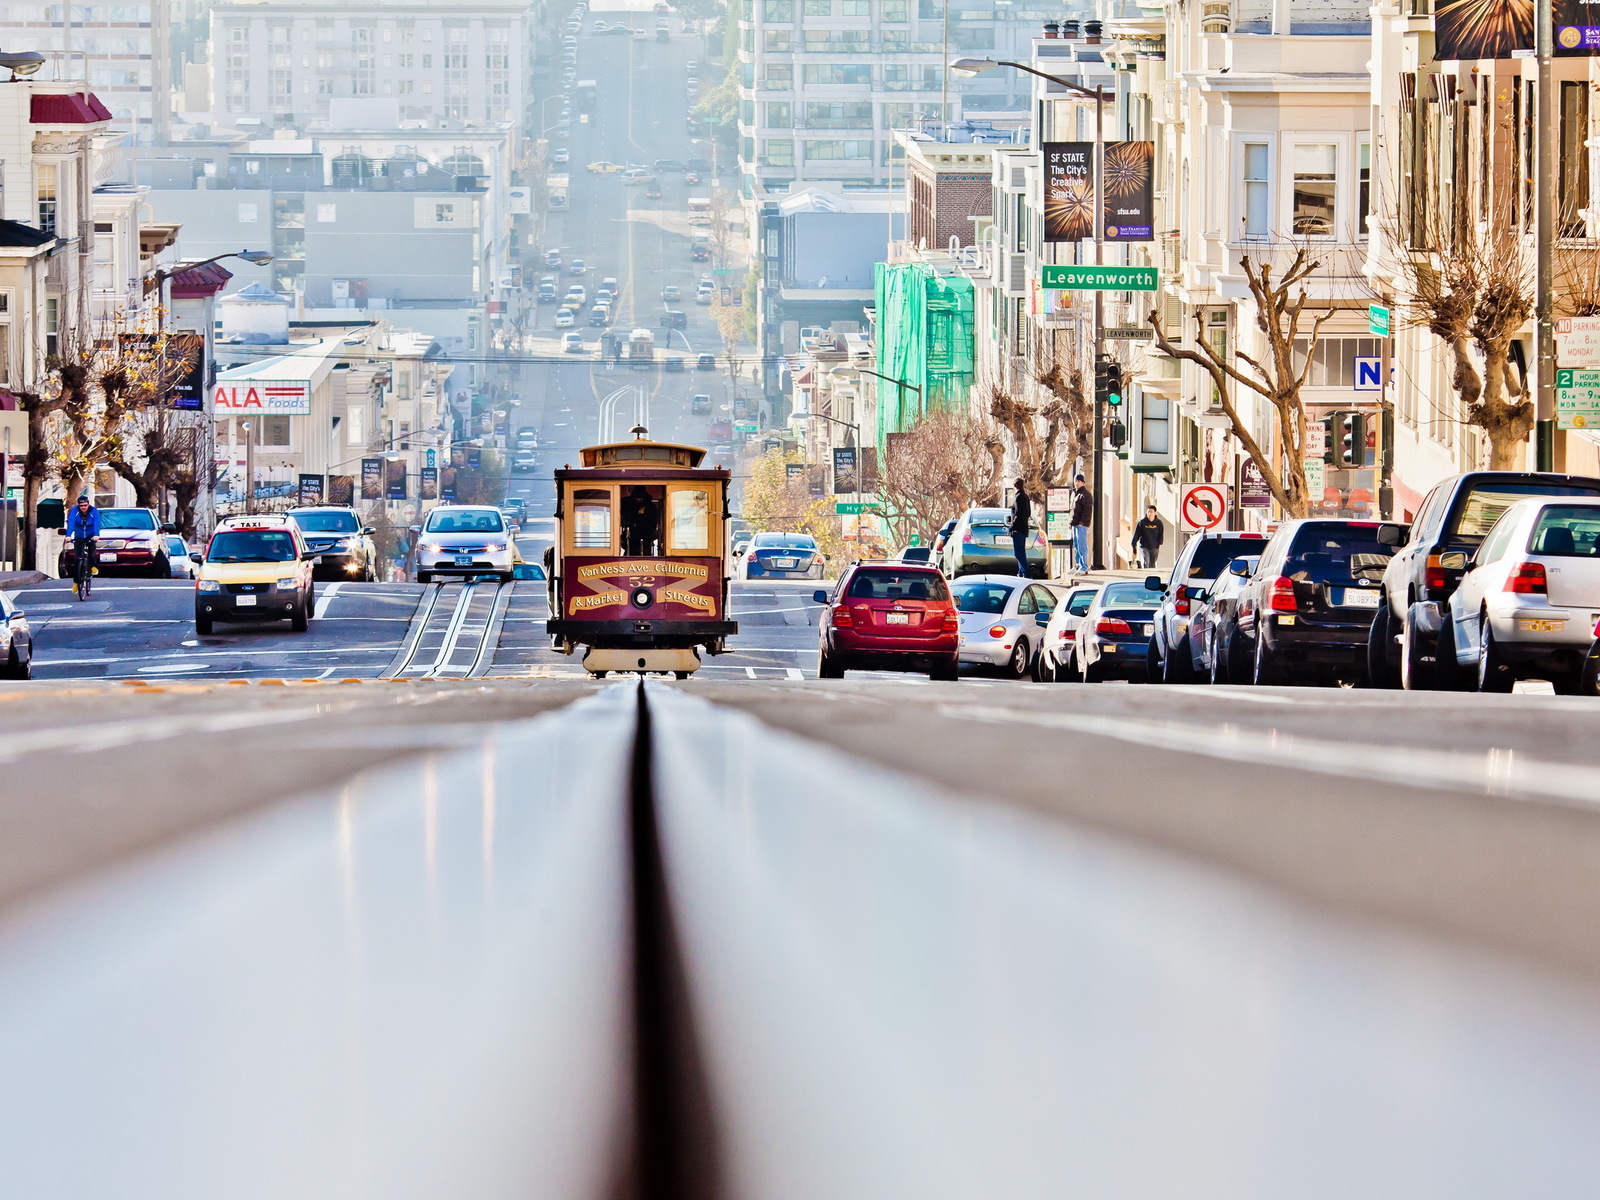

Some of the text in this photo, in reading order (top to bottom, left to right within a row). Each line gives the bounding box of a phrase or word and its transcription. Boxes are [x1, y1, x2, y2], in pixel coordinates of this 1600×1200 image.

[1051, 153, 1085, 162] SF STATE
[1051, 165, 1087, 176] The City's
[1051, 177, 1083, 187] Creative
[1051, 189, 1074, 199] Spark
[1047, 271, 1153, 286] Leavenworth
[1558, 320, 1600, 332] NO PARKING
[1563, 336, 1568, 344] 7
[1585, 335, 1590, 344] 8
[1567, 348, 1594, 356] MONDAY
[1560, 372, 1570, 385] 2
[1561, 390, 1567, 400] 8
[1588, 390, 1593, 399] 9
[268, 397, 304, 407] Foods
[1306, 425, 1323, 433] ARKING
[580, 567, 599, 577] Van
[600, 564, 625, 574] Ness
[655, 564, 707, 576] California
[629, 577, 655, 587] 52
[575, 590, 708, 607] & Market Streets
